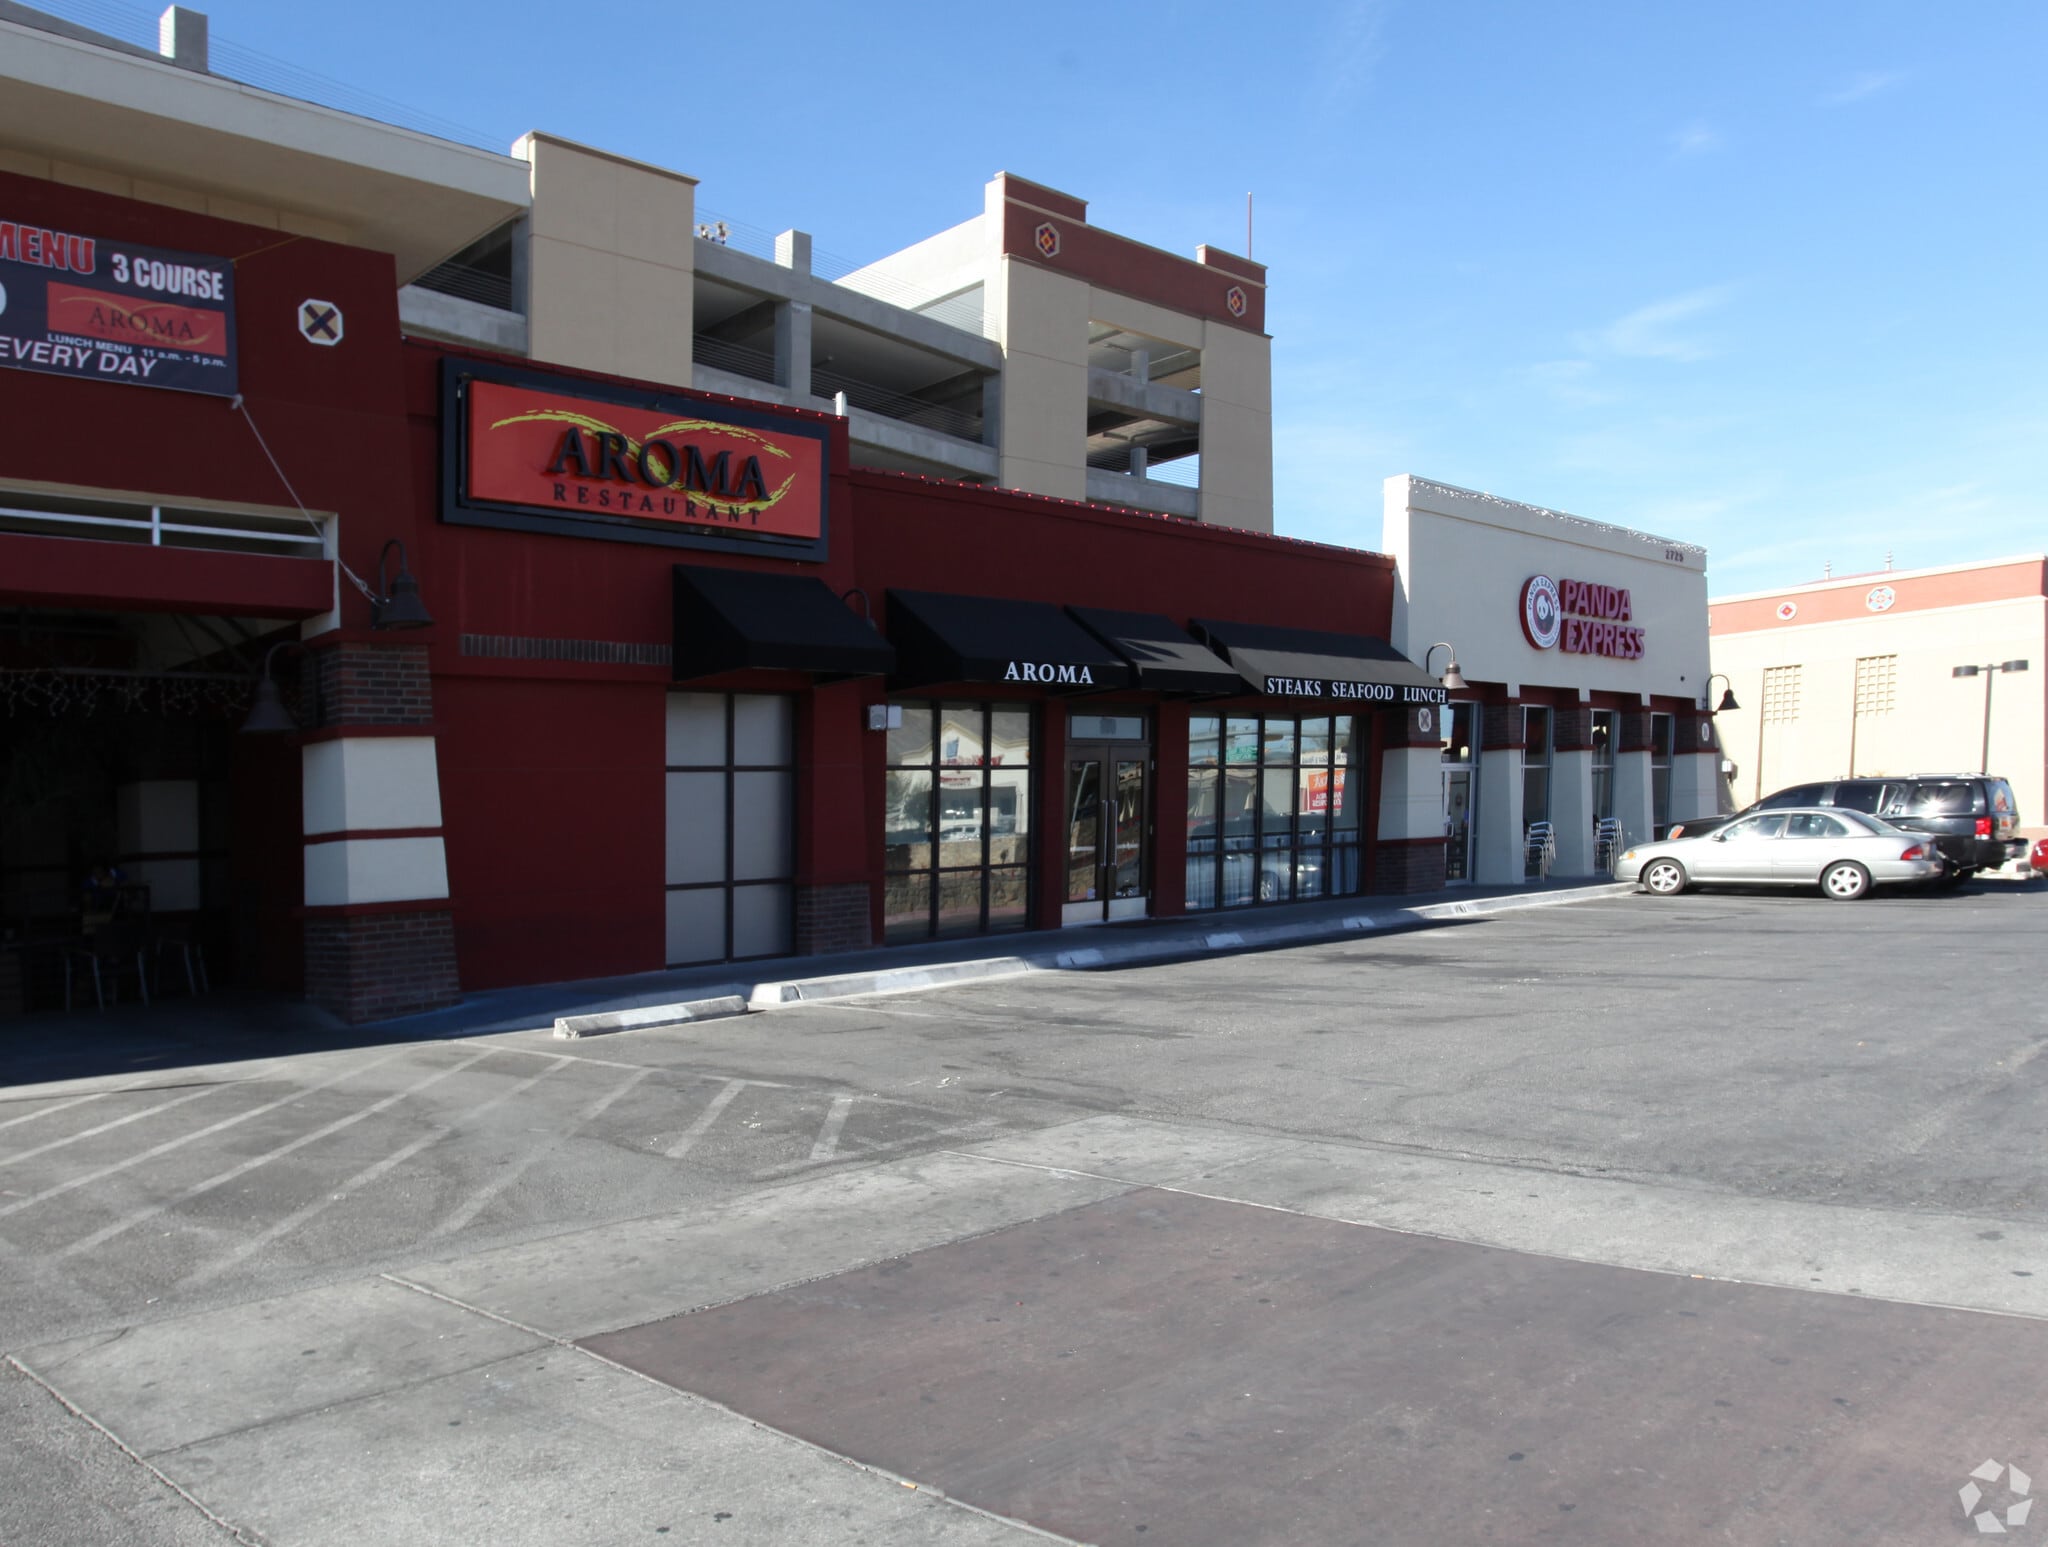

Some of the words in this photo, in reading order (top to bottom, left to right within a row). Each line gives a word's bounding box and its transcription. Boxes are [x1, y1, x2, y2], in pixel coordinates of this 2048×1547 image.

[111, 253, 130, 283] 3
[133, 257, 225, 301] COURSE
[88, 307, 195, 339] AROMA
[47, 333, 93, 348] LUNCH
[95, 341, 133, 355] MENU
[142, 348, 155, 358] 11
[158, 351, 183, 361] a.m.
[193, 354, 200, 363] 5
[202, 357, 228, 368] p.m.
[98, 352, 158, 378] DAY
[546, 426, 773, 502] AROMA
[553, 483, 761, 526] RESTAURANT
[1561, 579, 1632, 622] PANDA
[1560, 619, 1646, 660] EXPRESS
[1003, 661, 1094, 684] AROMA
[1267, 677, 1322, 697] STEAKS
[1332, 681, 1395, 701] SEAFOOD
[1403, 686, 1447, 703] LUNCH
